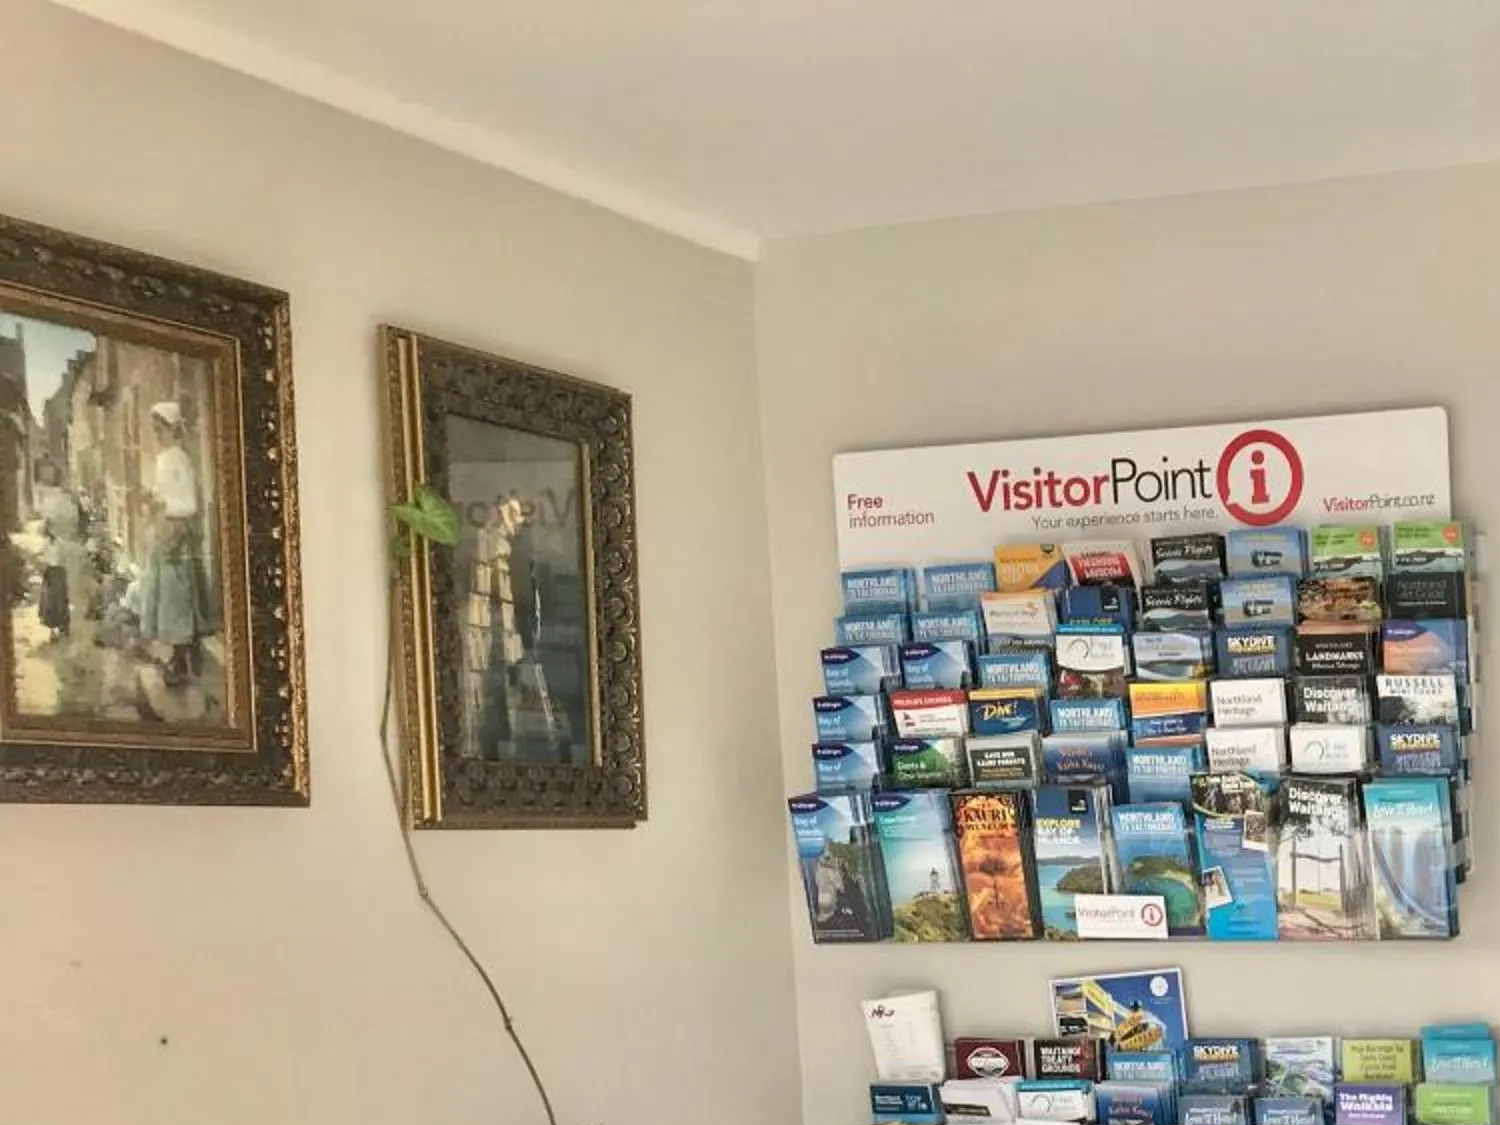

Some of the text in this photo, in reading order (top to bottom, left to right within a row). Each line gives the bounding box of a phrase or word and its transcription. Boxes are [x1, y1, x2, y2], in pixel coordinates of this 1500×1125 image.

[847, 494, 883, 509] Free
[1322, 493, 1436, 512] VisitorPoint.co.nz
[849, 509, 935, 529] information
[1032, 504, 1218, 530] Your experience starts here.
[1305, 651, 1365, 661] LANDMARKS
[1384, 676, 1444, 688] RUSSELL
[1303, 687, 1357, 700] Discover
[1288, 787, 1342, 801] Discover
[965, 807, 1008, 823] KAURI
[1339, 1093, 1357, 1102] The
[1340, 1101, 1393, 1112] Waikato
